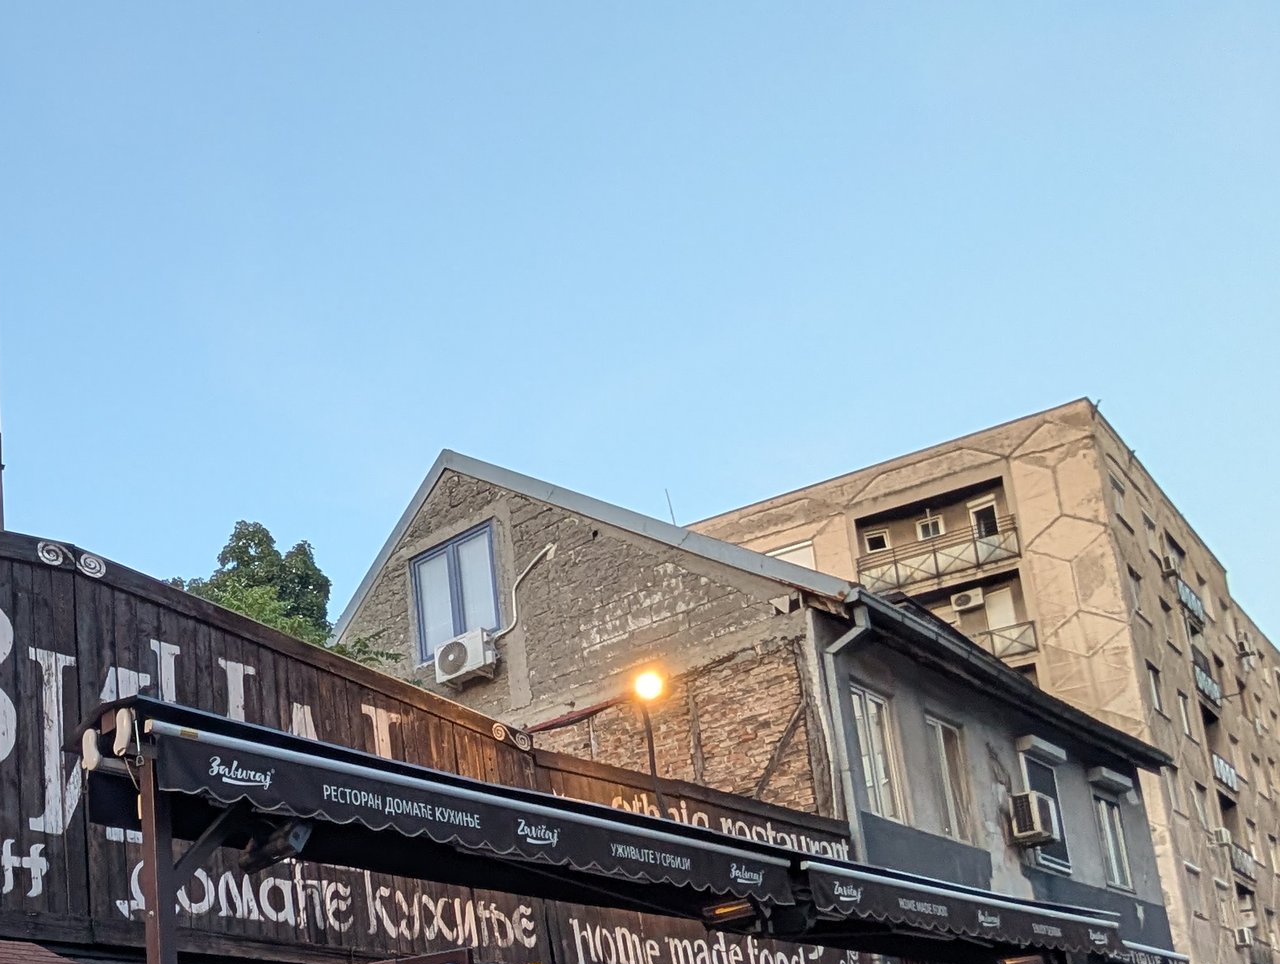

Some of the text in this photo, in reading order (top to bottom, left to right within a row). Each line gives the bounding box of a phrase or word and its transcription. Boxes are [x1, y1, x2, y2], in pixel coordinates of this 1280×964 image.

[323, 784, 481, 829] РЕСТОРАН ДОМАЋЕ КУХИЊЕ
[517, 819, 559, 847] Zavičaj
[610, 843, 655, 865] УЖИВАЈТЕ
